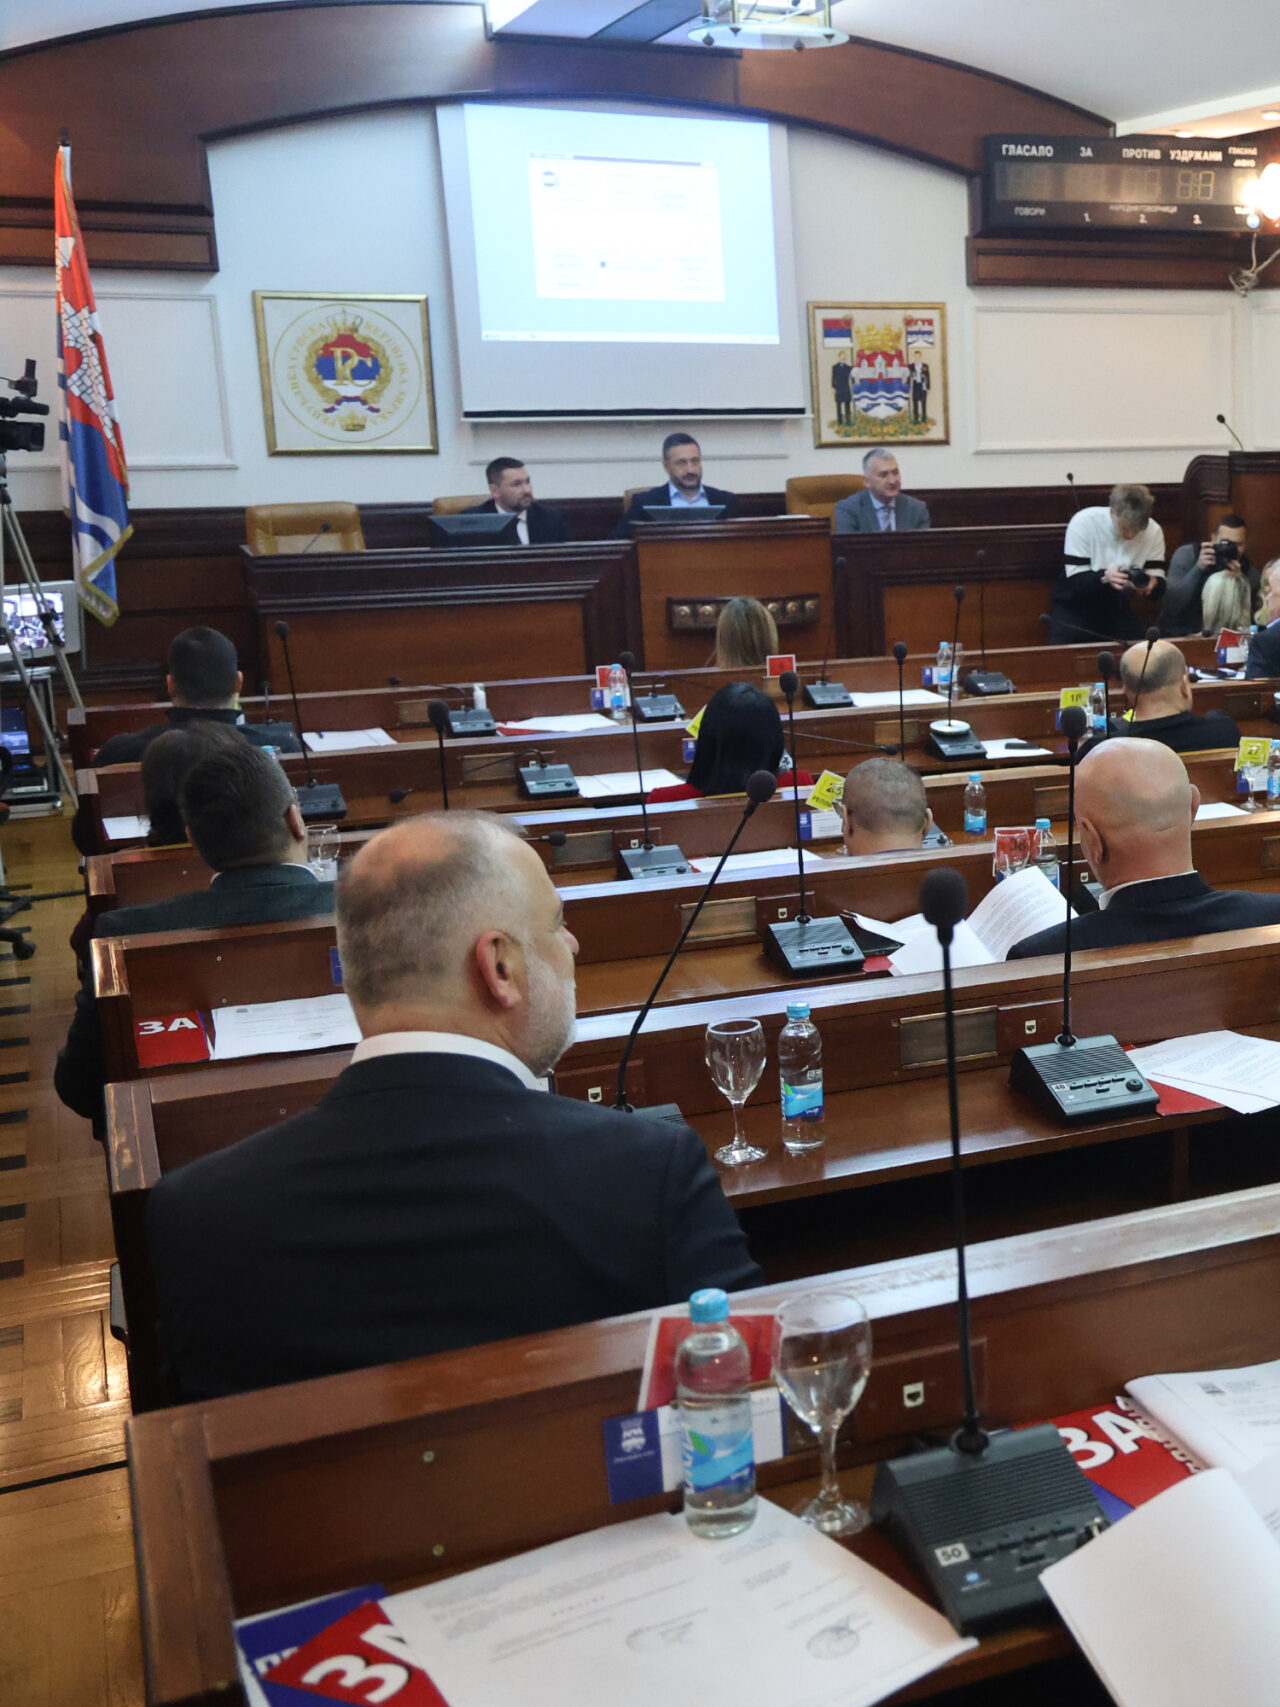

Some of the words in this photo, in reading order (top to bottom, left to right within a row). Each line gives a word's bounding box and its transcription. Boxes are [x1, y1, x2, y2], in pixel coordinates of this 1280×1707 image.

[1001, 143, 1054, 157] ГЛАСАЛО
[1079, 146, 1093, 157] ЗА
[1122, 148, 1162, 160] ПРОТИВ
[1169, 149, 1223, 162] УЗДРЖАНИ
[138, 1017, 198, 1036] ЗА
[1058, 1410, 1146, 1470] ЗА
[940, 1546, 962, 1561] 50
